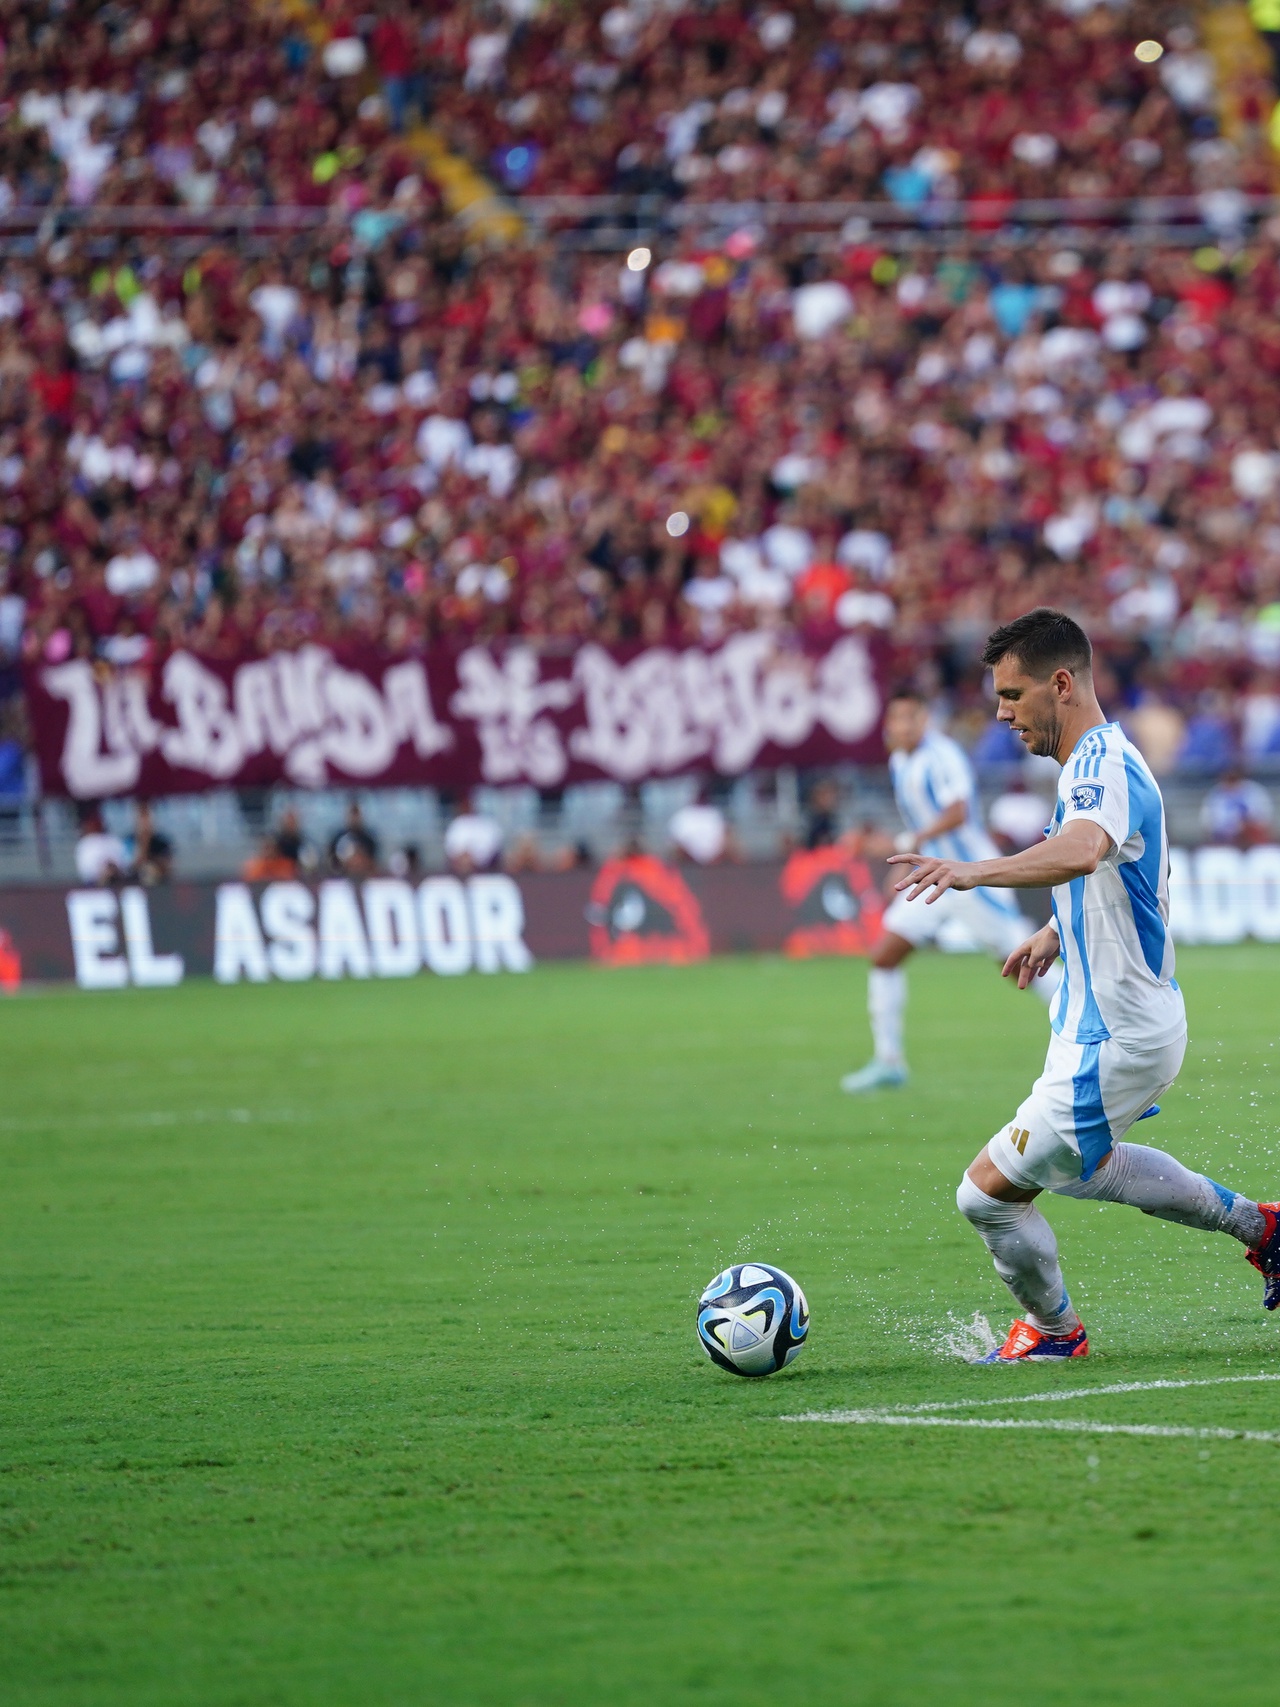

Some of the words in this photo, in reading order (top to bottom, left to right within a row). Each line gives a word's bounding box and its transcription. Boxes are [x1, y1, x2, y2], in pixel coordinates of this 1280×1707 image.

[41, 656, 162, 800] LA
[161, 643, 455, 788] BANDA
[66, 886, 184, 989] EL
[213, 874, 533, 985] ASADOR
